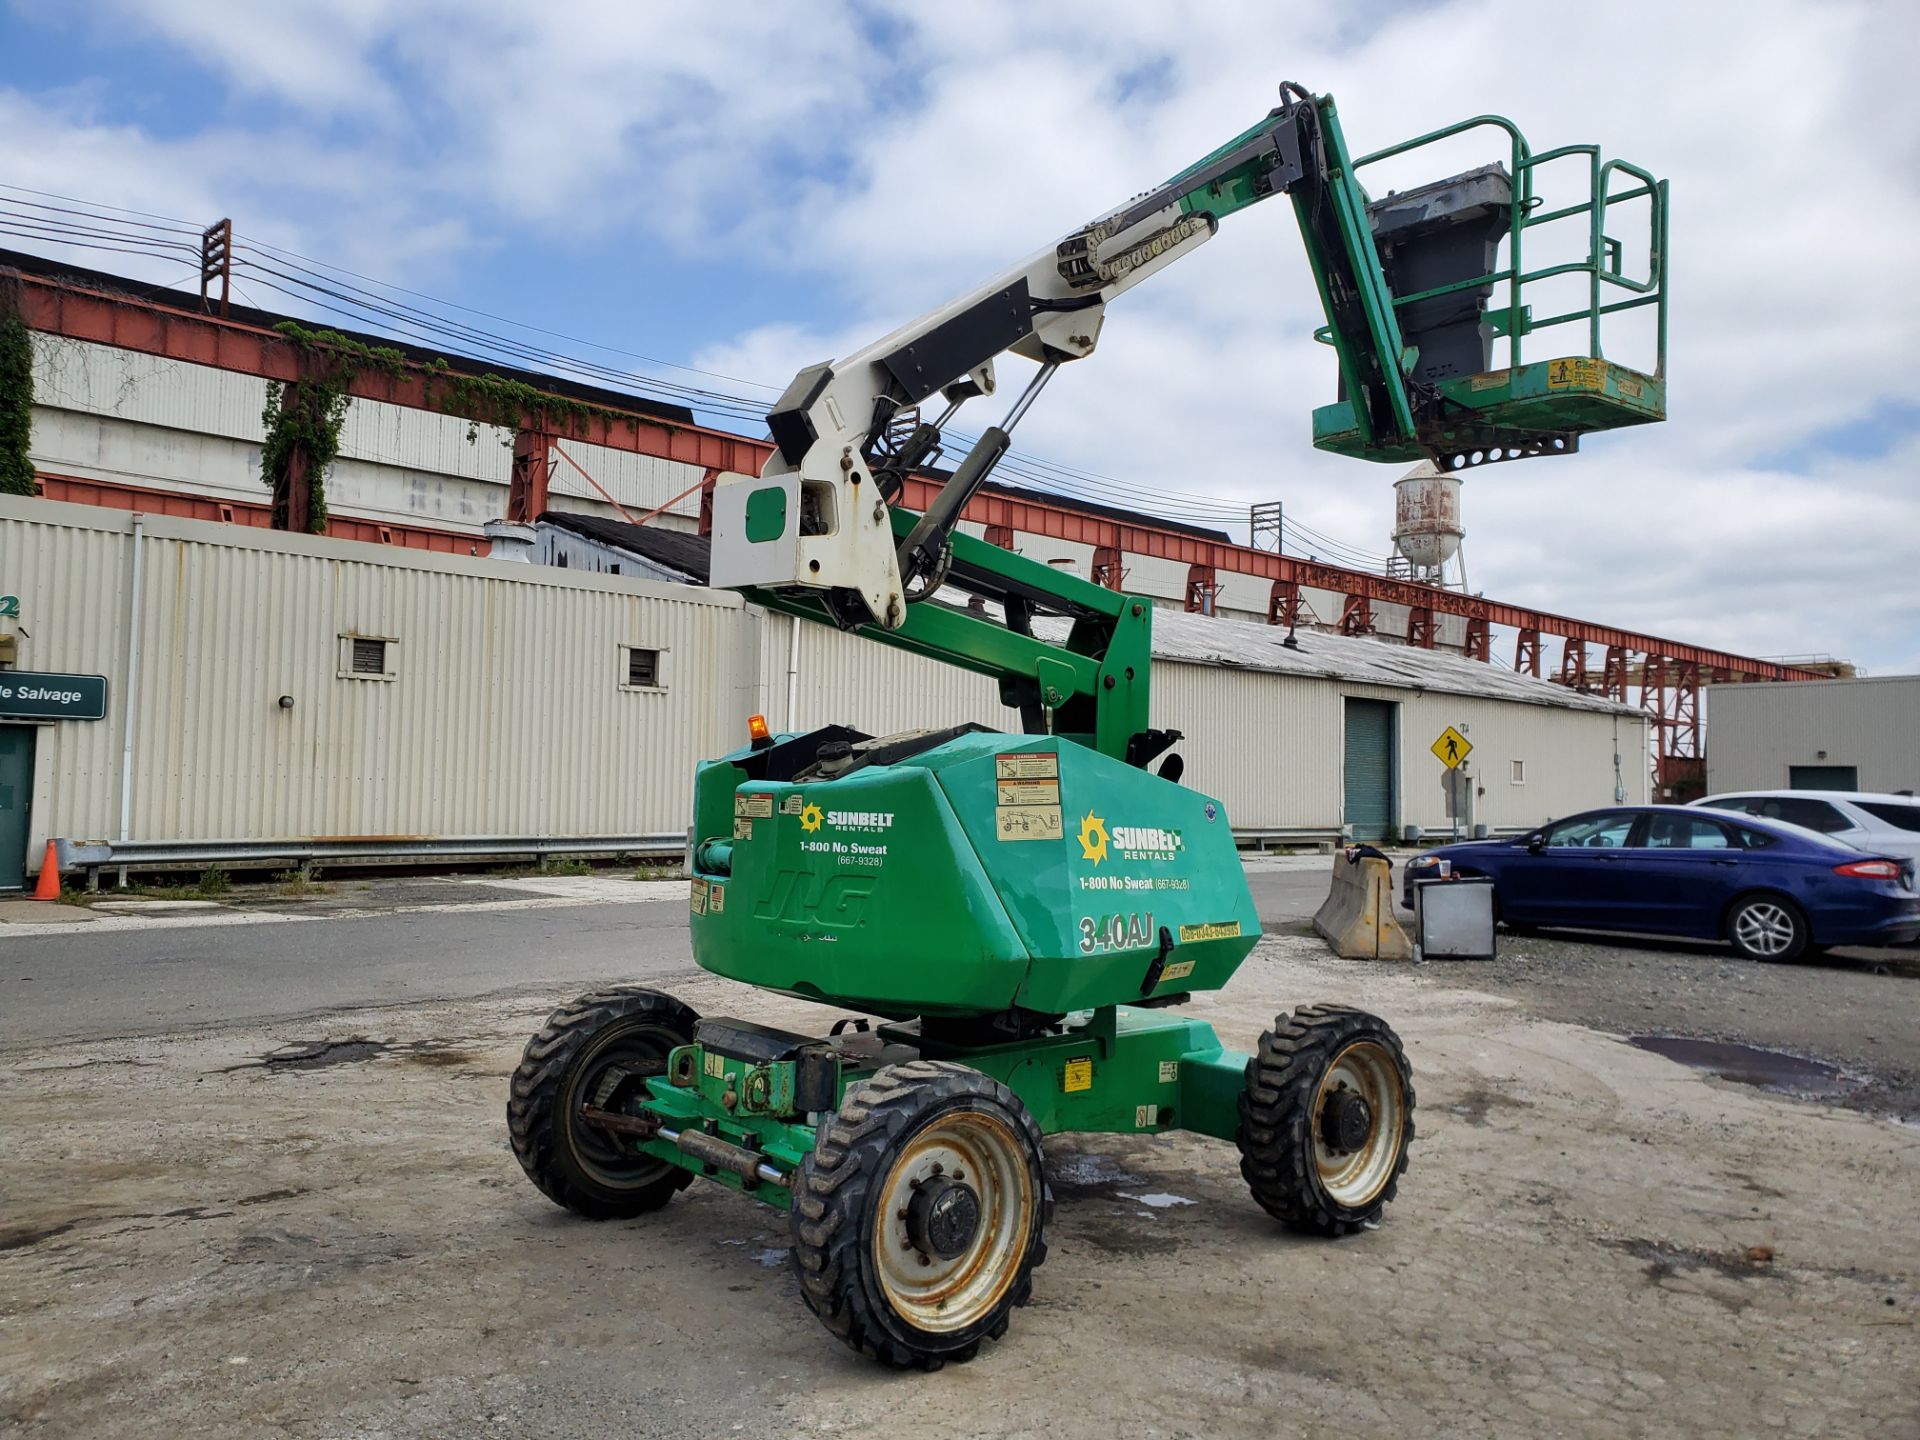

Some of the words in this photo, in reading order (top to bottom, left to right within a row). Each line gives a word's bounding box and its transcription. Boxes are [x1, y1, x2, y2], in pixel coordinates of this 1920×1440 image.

[17, 686, 82, 704] Salvage
[827, 811, 895, 827] SUNBELT
[835, 825, 884, 833] RENTALS
[800, 841, 830, 852] 1-800
[832, 842, 848, 853] No
[850, 843, 888, 855] Sweat
[837, 855, 883, 868] (667-9328)
[1124, 851, 1175, 861] RENTALS
[1080, 876, 1108, 890] 1-800
[1109, 876, 1123, 890] No
[1124, 876, 1154, 890] Sweat
[754, 870, 878, 928] JLG
[1079, 912, 1154, 953] 340AJ
